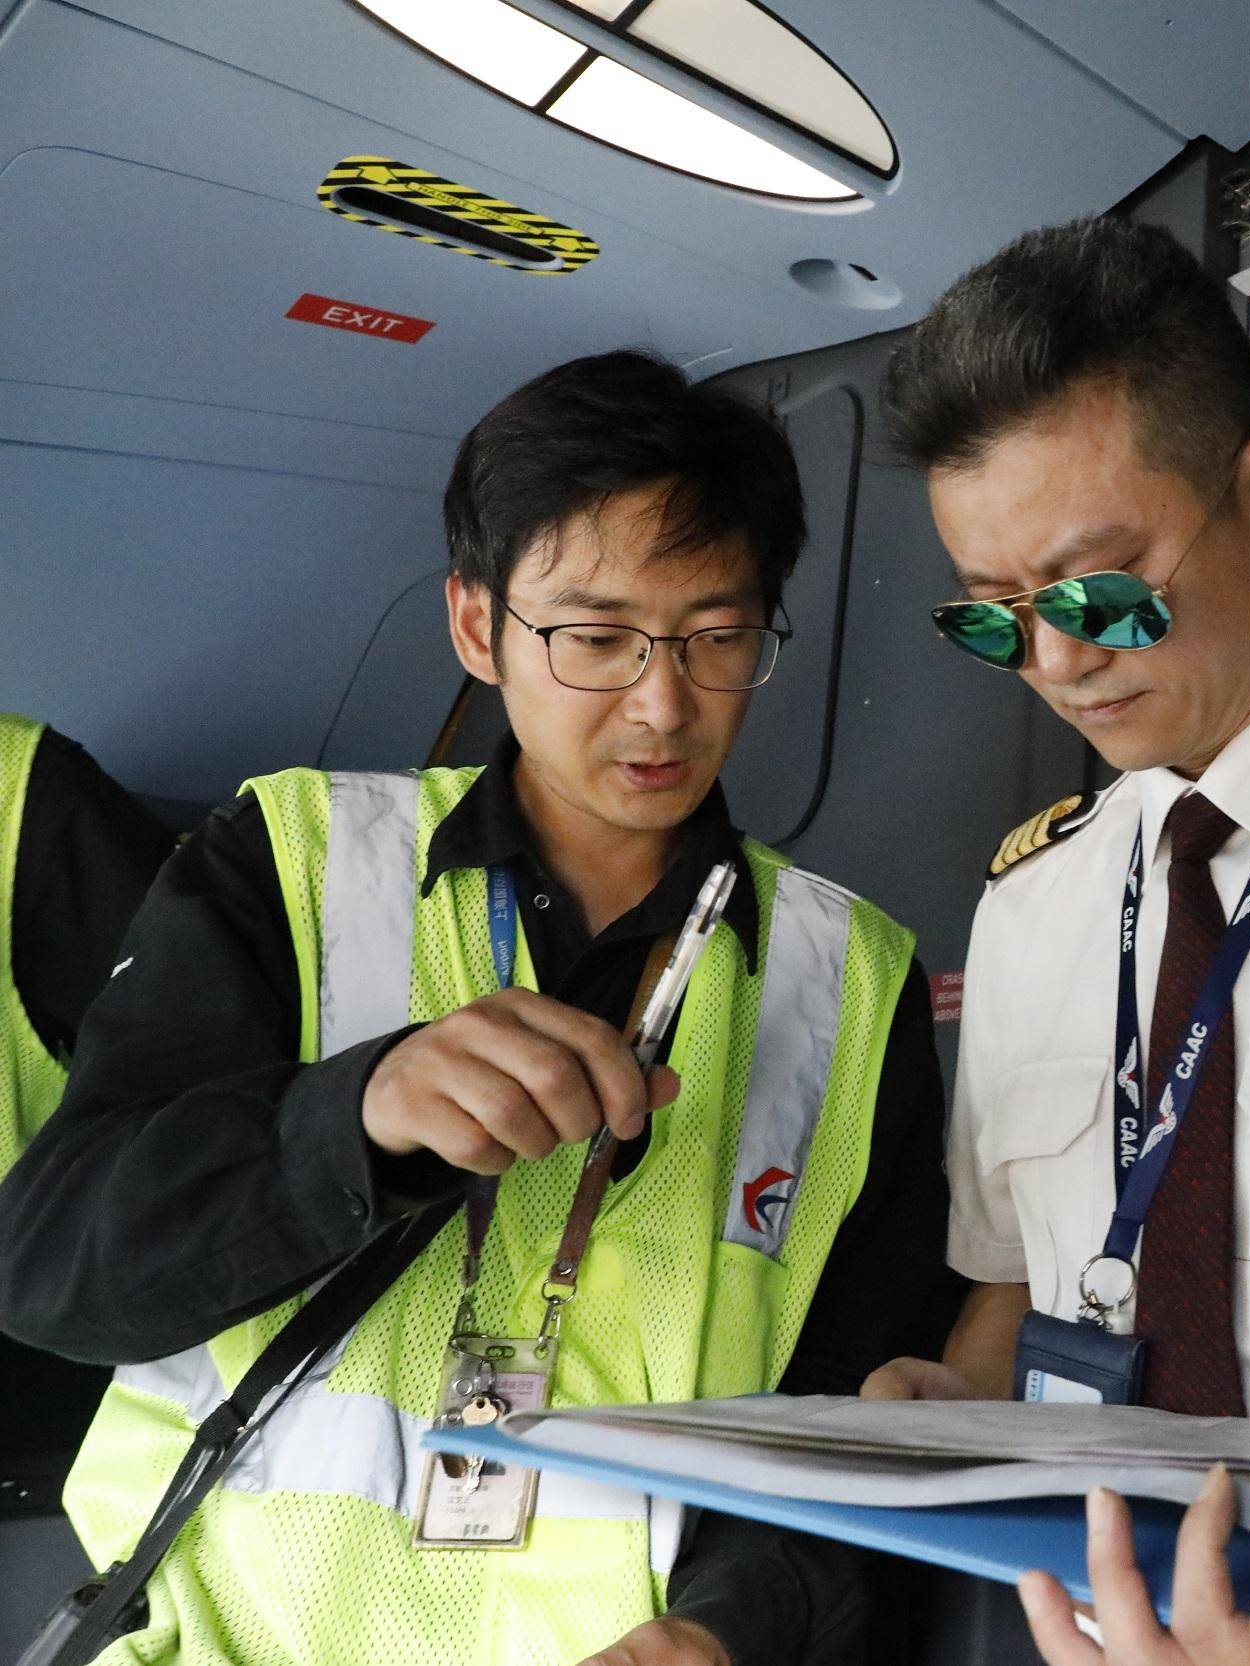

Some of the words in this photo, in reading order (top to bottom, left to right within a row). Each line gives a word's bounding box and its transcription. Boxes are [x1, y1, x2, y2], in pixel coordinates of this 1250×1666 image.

[417, 185, 468, 207] HANDLE
[322, 305, 404, 333] EXIT
[493, 869, 508, 921] 上海国际
[1122, 906, 1135, 953] CAAC
[497, 940, 511, 976] Airport
[942, 972, 964, 986] CRAS
[936, 991, 962, 1004] BEHIN
[1174, 1021, 1208, 1080] CAAC
[1119, 1116, 1139, 1169] CAAC
